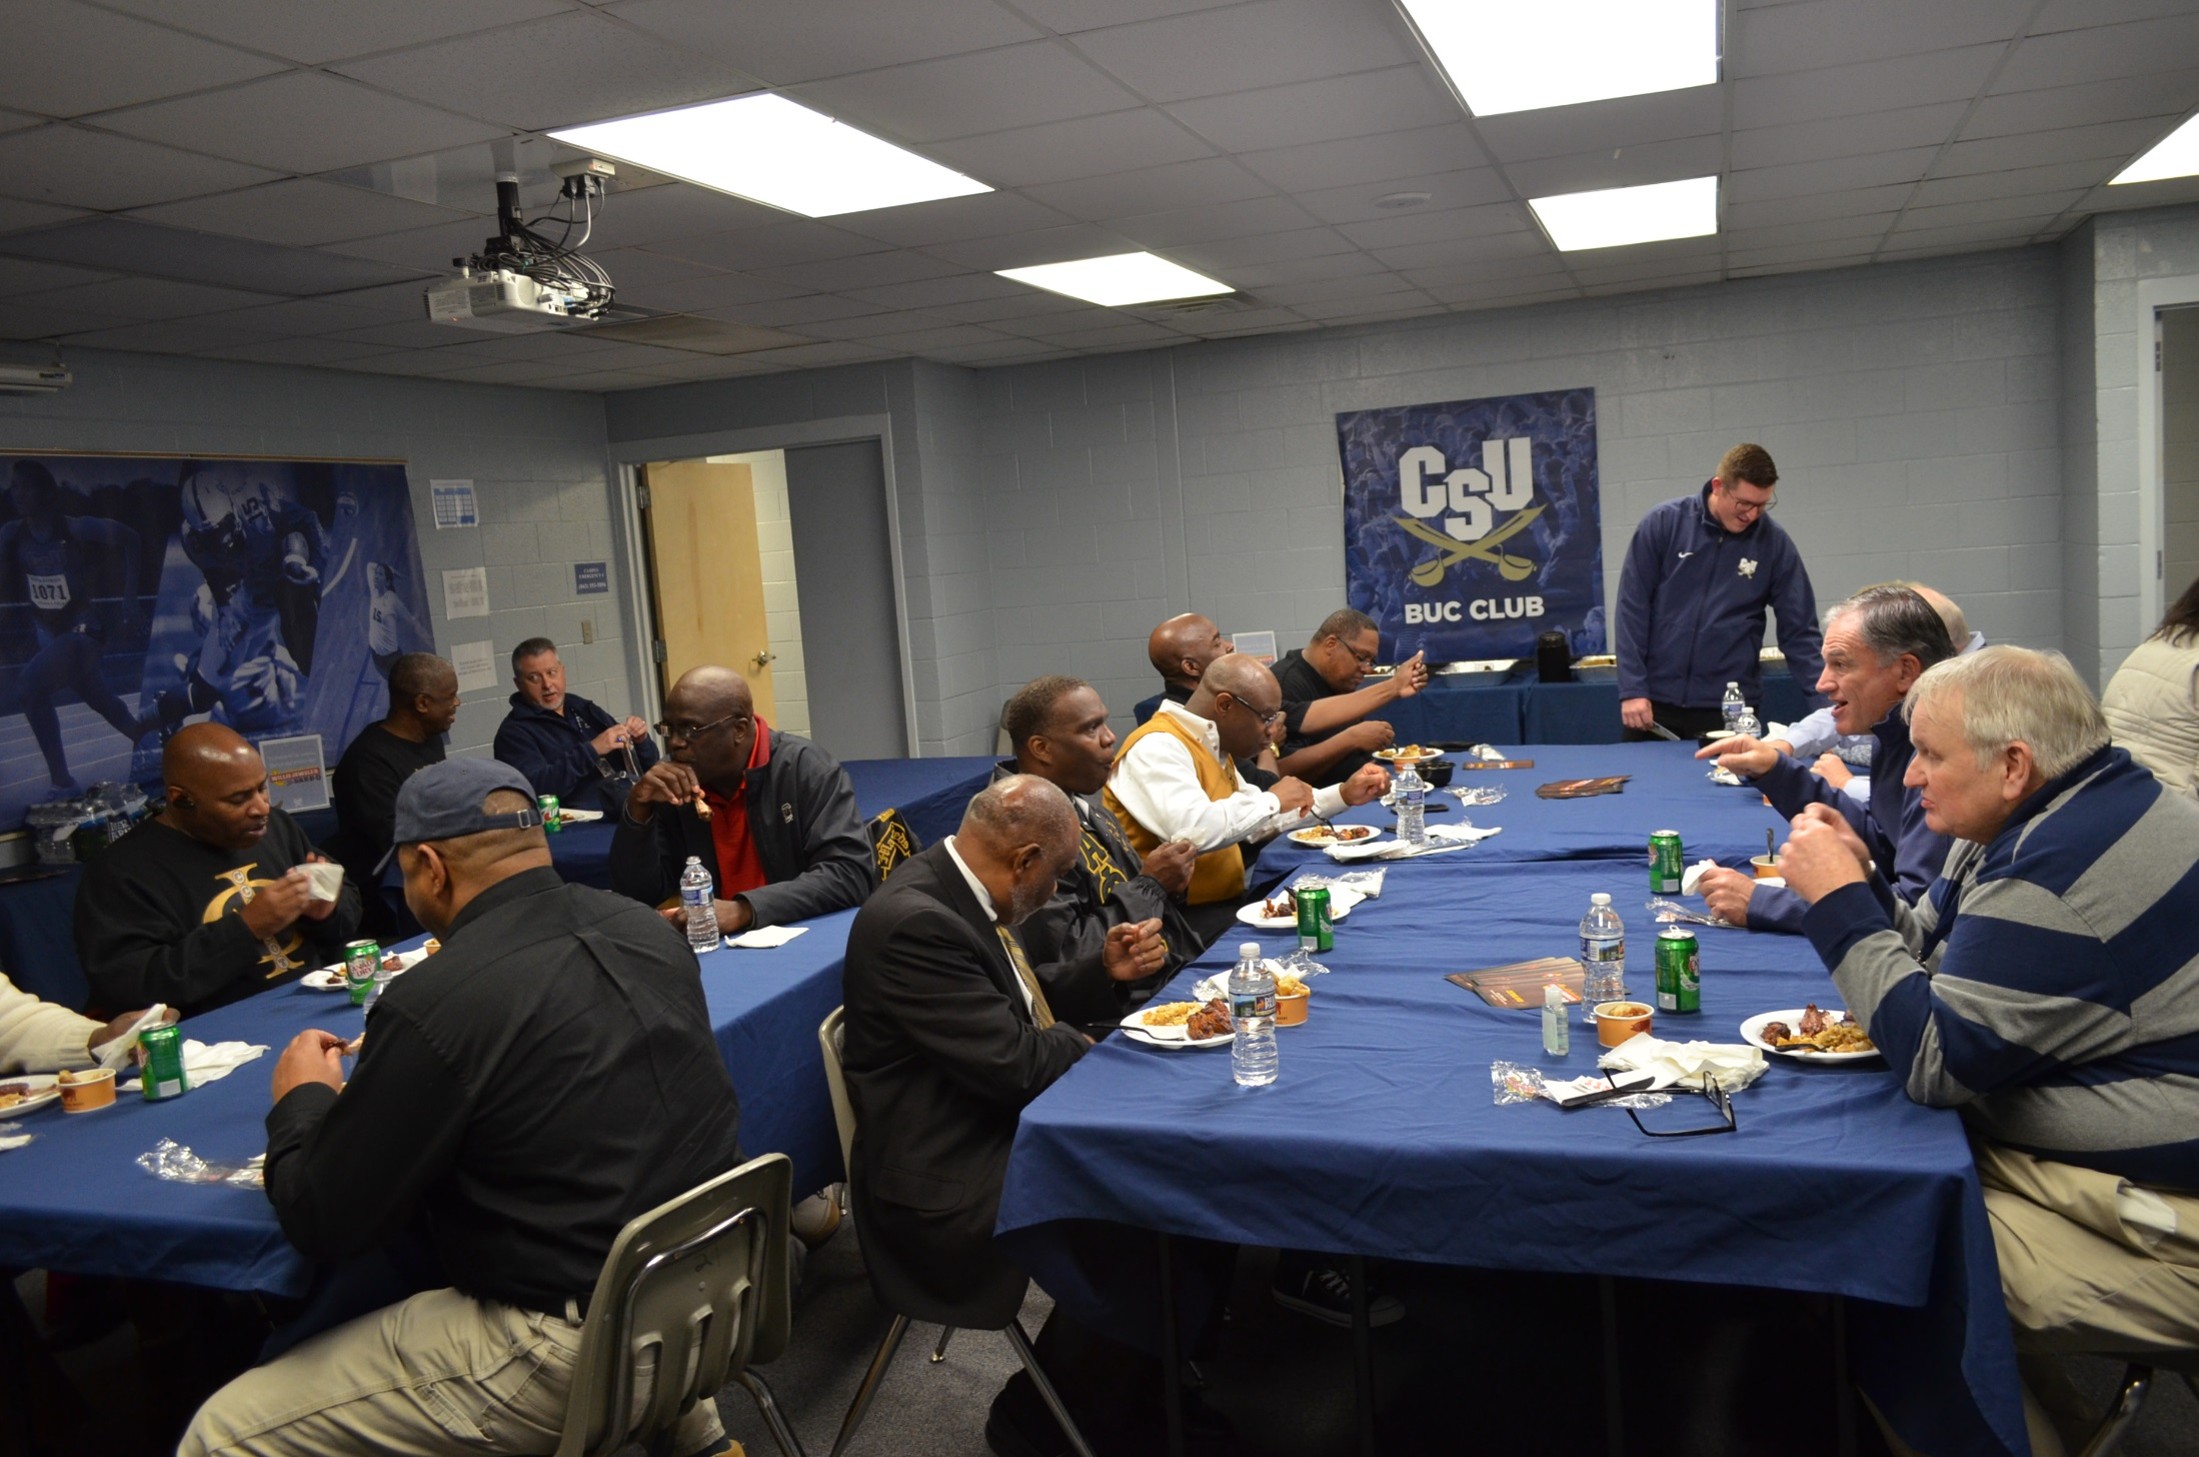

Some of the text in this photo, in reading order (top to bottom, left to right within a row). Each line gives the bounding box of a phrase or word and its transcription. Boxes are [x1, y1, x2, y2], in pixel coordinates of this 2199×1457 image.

[1398, 436, 1534, 541] CSU
[32, 584, 66, 600] 1071
[1404, 596, 1545, 624] BUC CLUB
